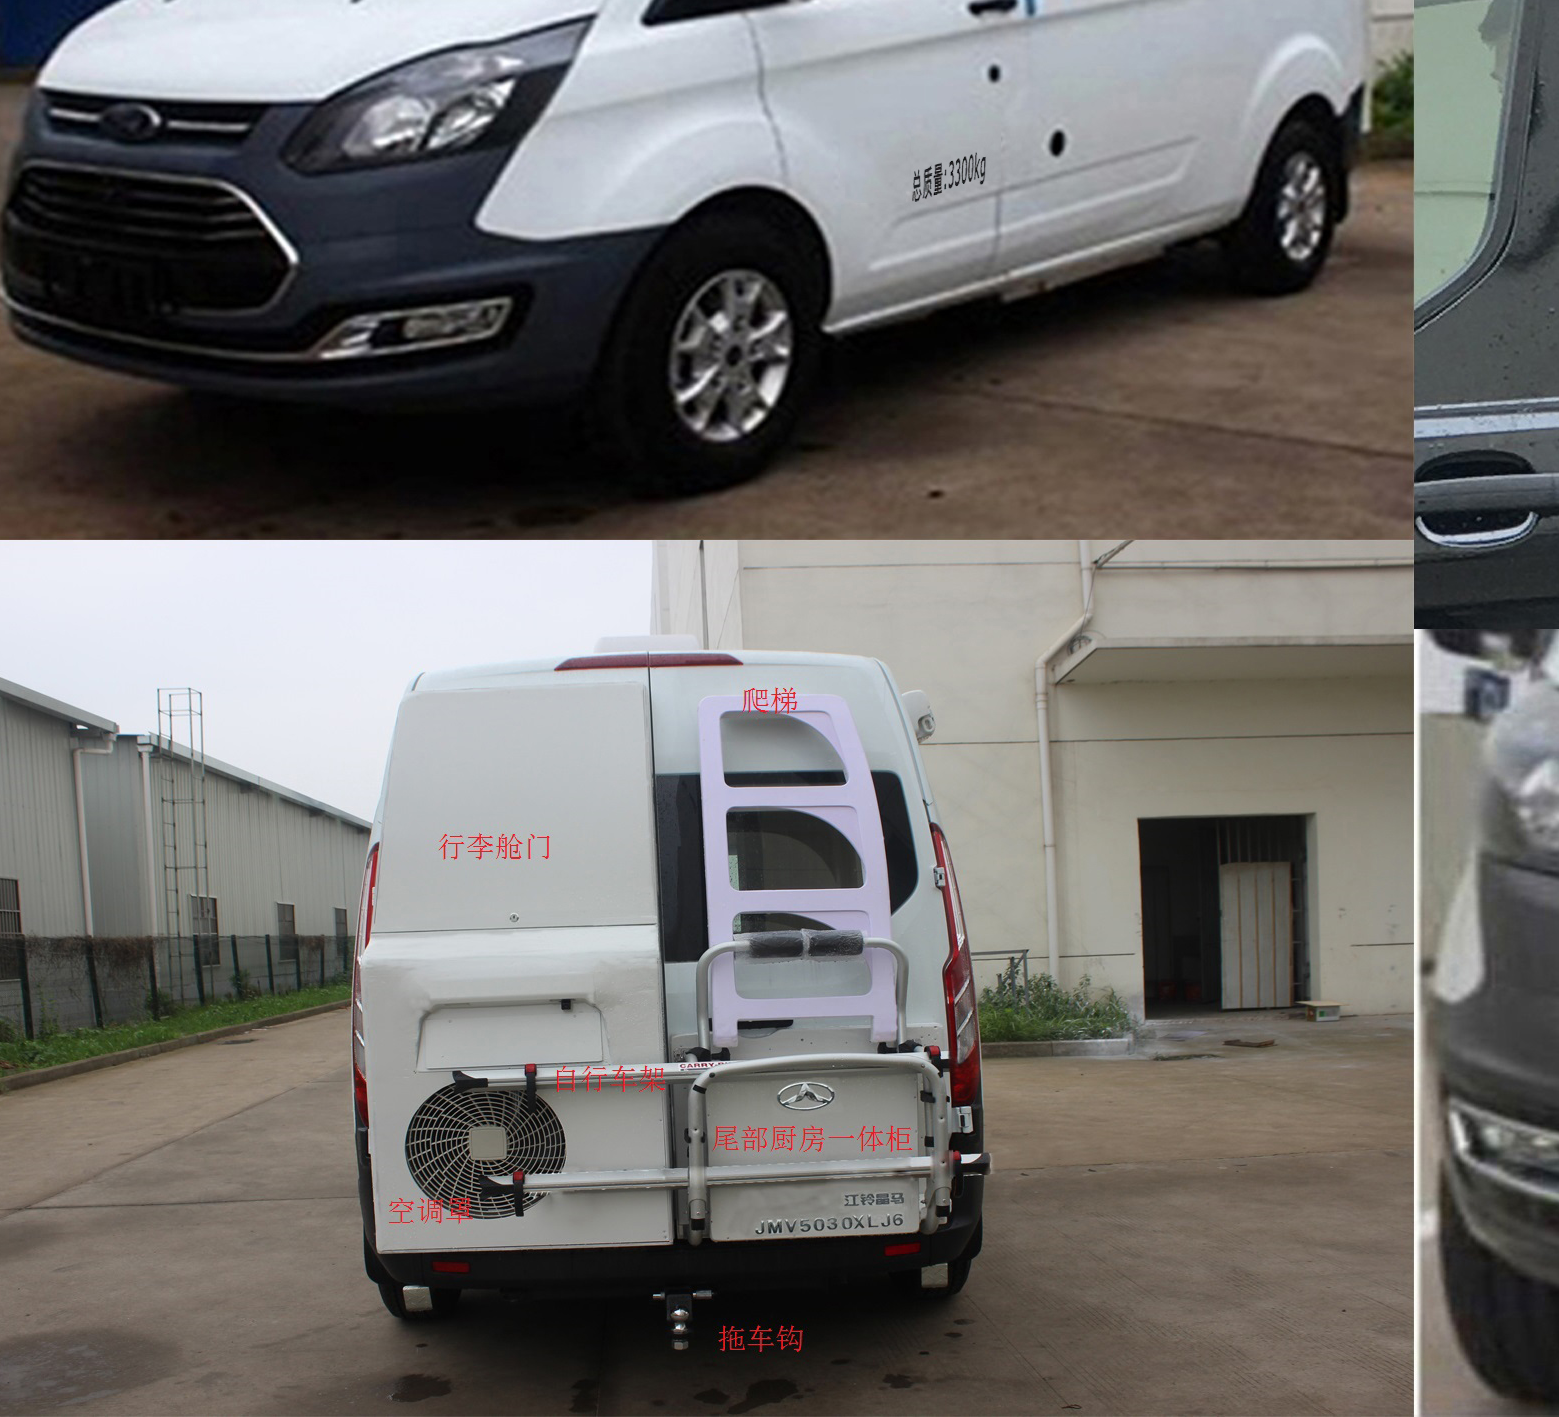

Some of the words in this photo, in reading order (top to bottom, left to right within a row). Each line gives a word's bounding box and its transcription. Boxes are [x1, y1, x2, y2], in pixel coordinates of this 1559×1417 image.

[911, 152, 986, 202] 总质量:3300kg
[755, 1213, 904, 1236] JMV5030XLJ6
